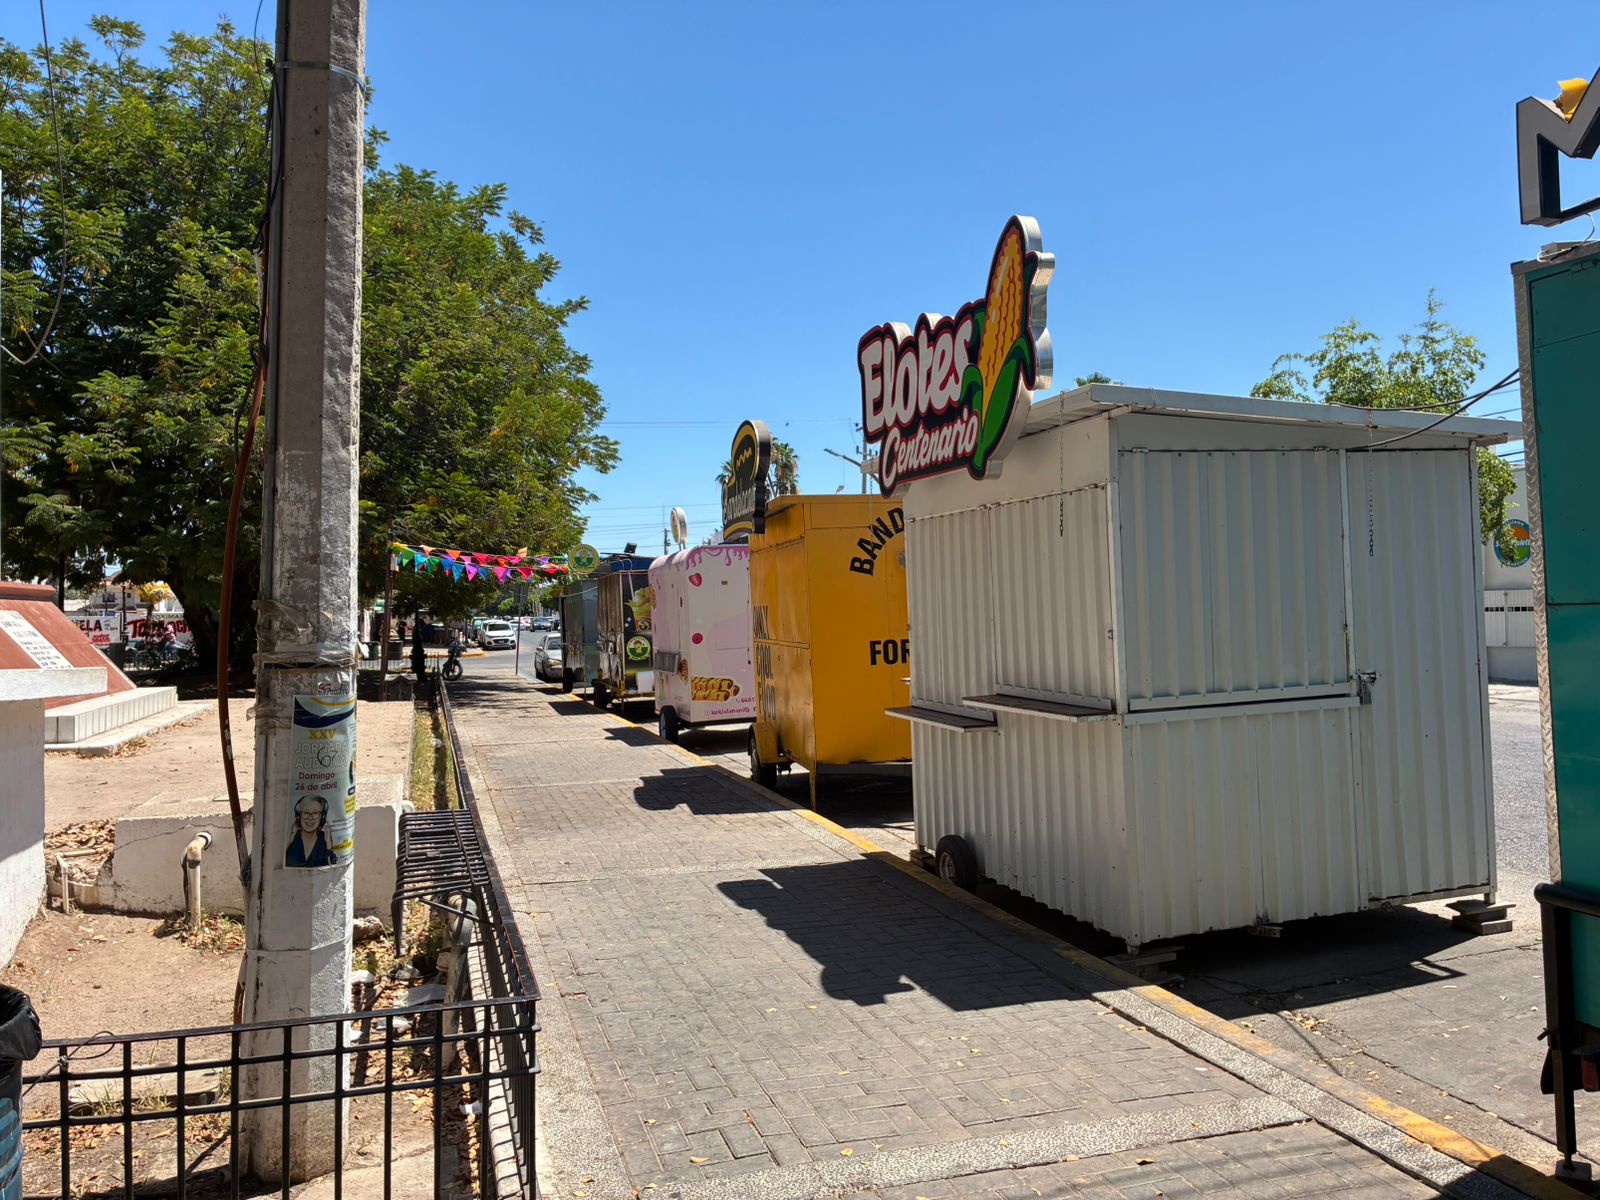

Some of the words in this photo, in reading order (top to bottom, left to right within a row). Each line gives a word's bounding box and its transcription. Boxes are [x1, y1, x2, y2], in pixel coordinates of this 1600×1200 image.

[861, 319, 973, 433] Elotes
[882, 408, 979, 488] Centenario
[308, 729, 336, 740] XXV
[295, 742, 348, 755] JORNADA
[298, 772, 335, 781] Domingo
[295, 782, 305, 791] 26
[307, 783, 319, 791] de
[321, 781, 338, 791] abril
